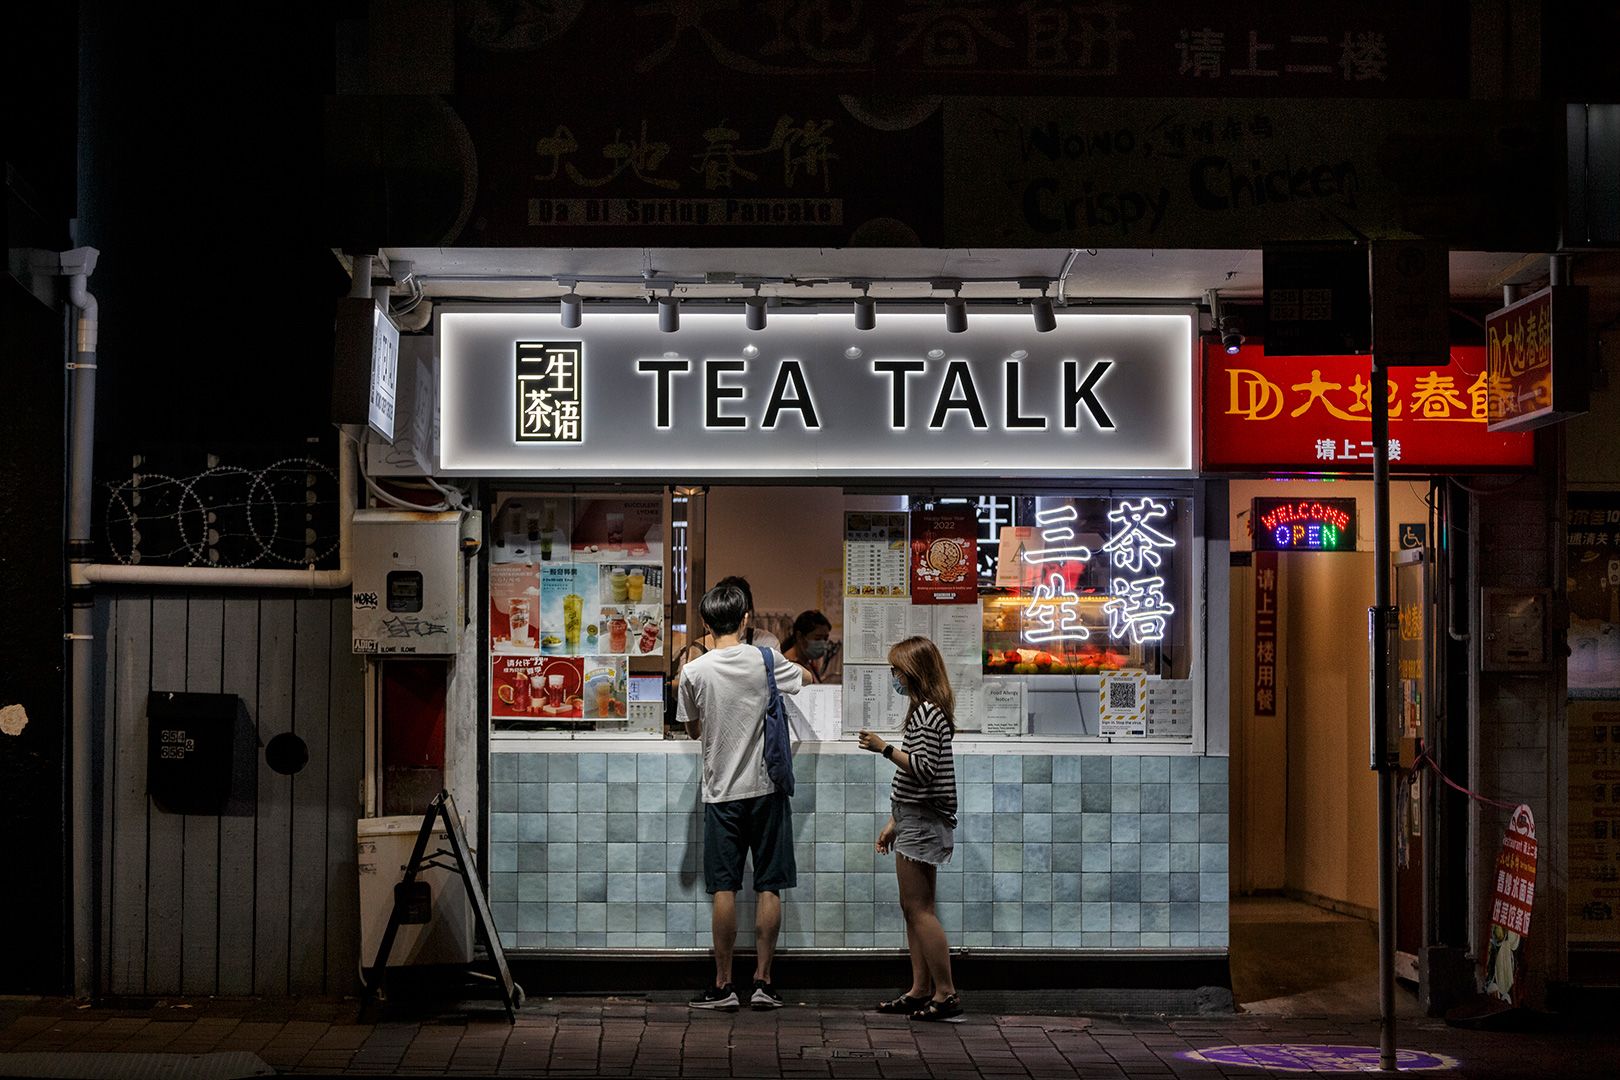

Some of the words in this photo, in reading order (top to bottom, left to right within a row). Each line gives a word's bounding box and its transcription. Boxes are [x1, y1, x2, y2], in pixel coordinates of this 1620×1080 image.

[1174, 27, 1391, 82] 请上二楼
[1189, 155, 1360, 210] Chicken
[539, 201, 569, 222] Da
[586, 201, 609, 222] Di
[626, 200, 709, 225] Spring
[726, 200, 831, 222] Pancake
[1023, 178, 1169, 234] Crispy
[639, 360, 820, 429] TEA
[873, 360, 1117, 429] TALK
[933, 521, 955, 529] 2022
[1261, 501, 1351, 532] WELCOME
[1276, 524, 1339, 546] OPEN
[1023, 504, 1092, 644] 三生
[1102, 497, 1177, 645] 茶语
[1256, 568, 1276, 711] 请上二楼用餐
[161, 730, 186, 742] 654
[161, 746, 185, 758] 656
[186, 739, 194, 750] &
